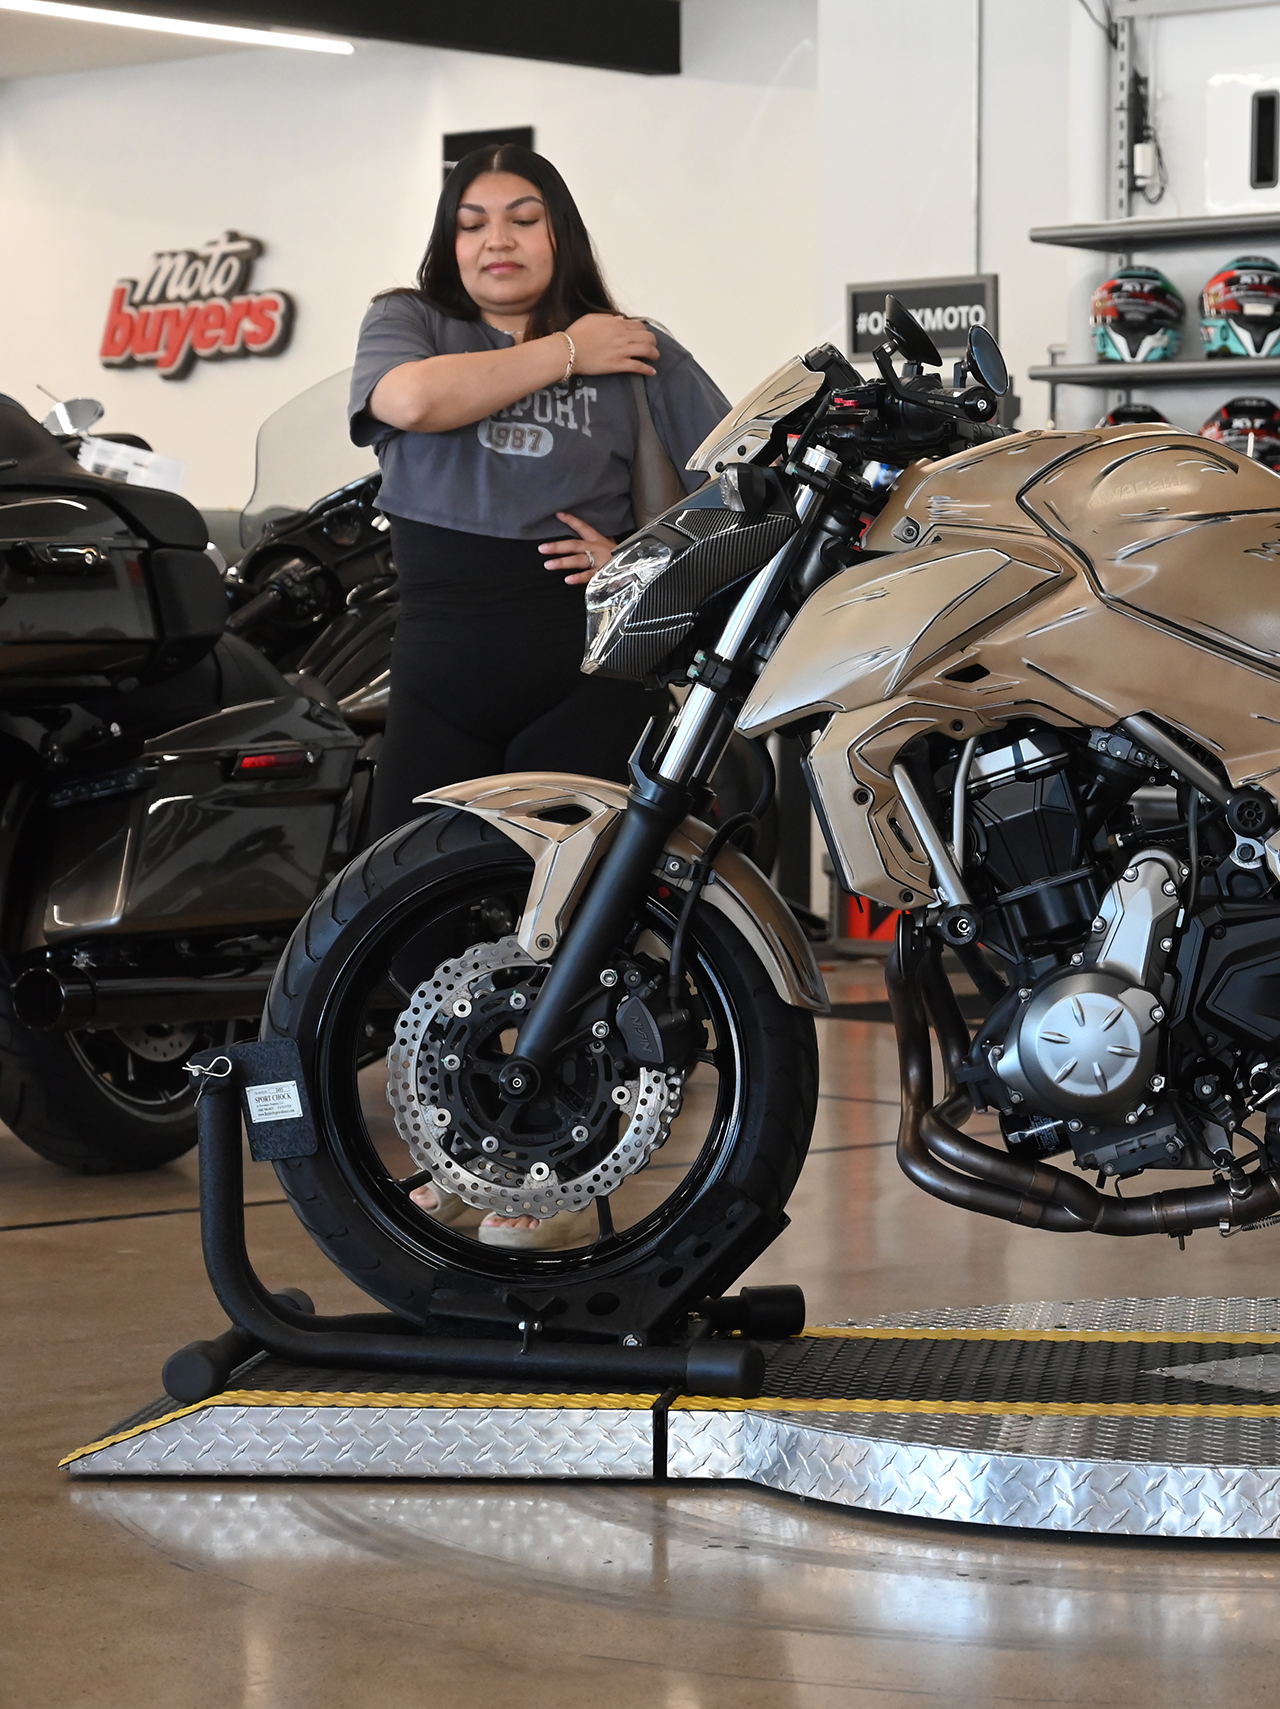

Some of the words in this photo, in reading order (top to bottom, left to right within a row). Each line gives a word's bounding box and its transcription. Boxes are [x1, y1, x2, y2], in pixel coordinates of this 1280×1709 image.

[99, 284, 282, 372] buyers
[487, 424, 544, 452] 1987
[254, 1094, 271, 1104] SPORT
[271, 1092, 292, 1102] CHOCK
